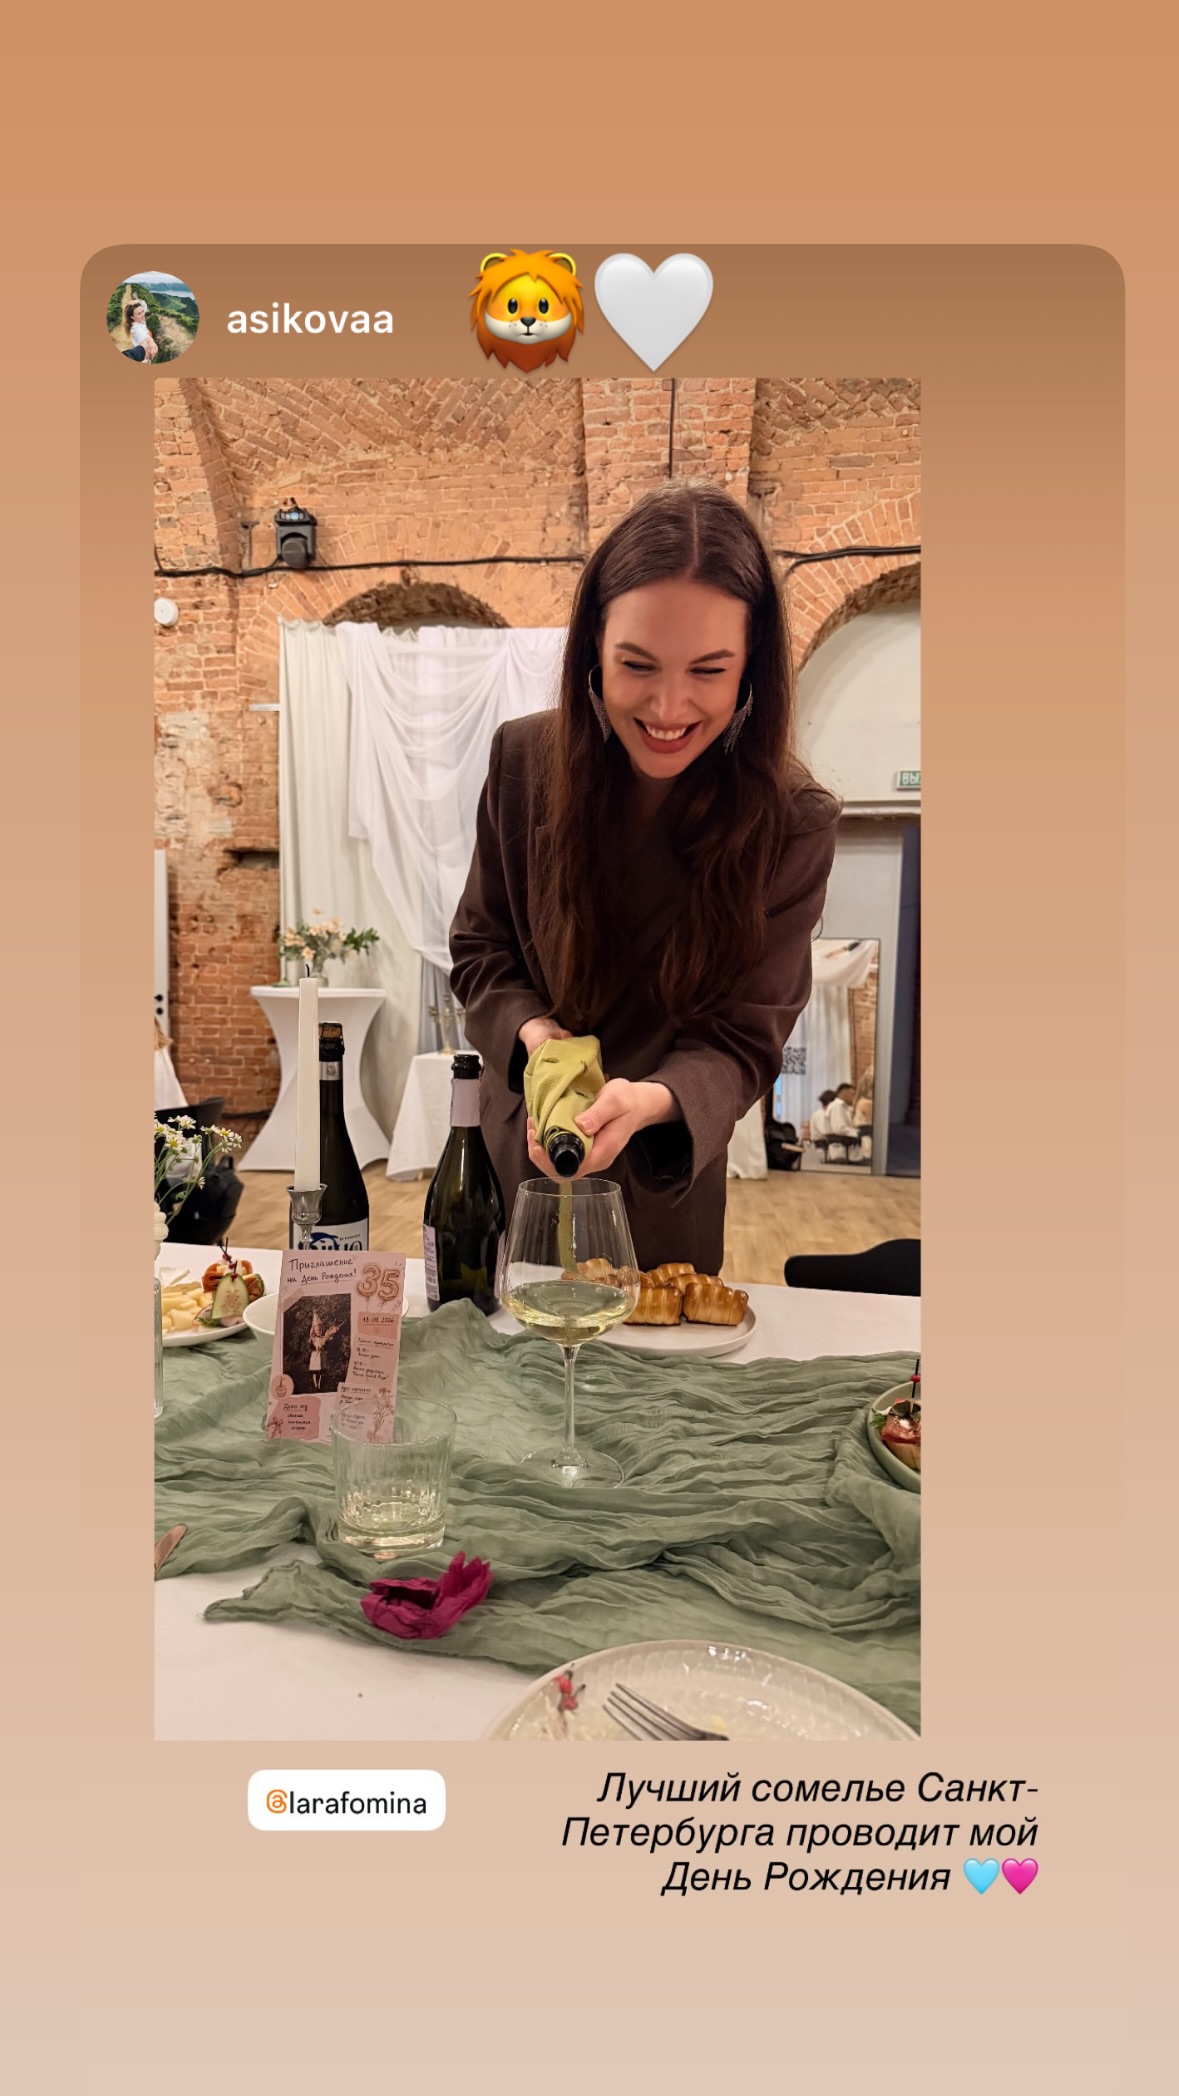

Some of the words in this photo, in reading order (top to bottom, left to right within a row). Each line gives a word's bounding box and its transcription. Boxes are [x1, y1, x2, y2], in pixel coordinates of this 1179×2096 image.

[288, 1258, 353, 1273] Приглашение
[287, 1276, 297, 1284] на
[301, 1274, 318, 1285] День
[356, 1264, 400, 1301] 35
